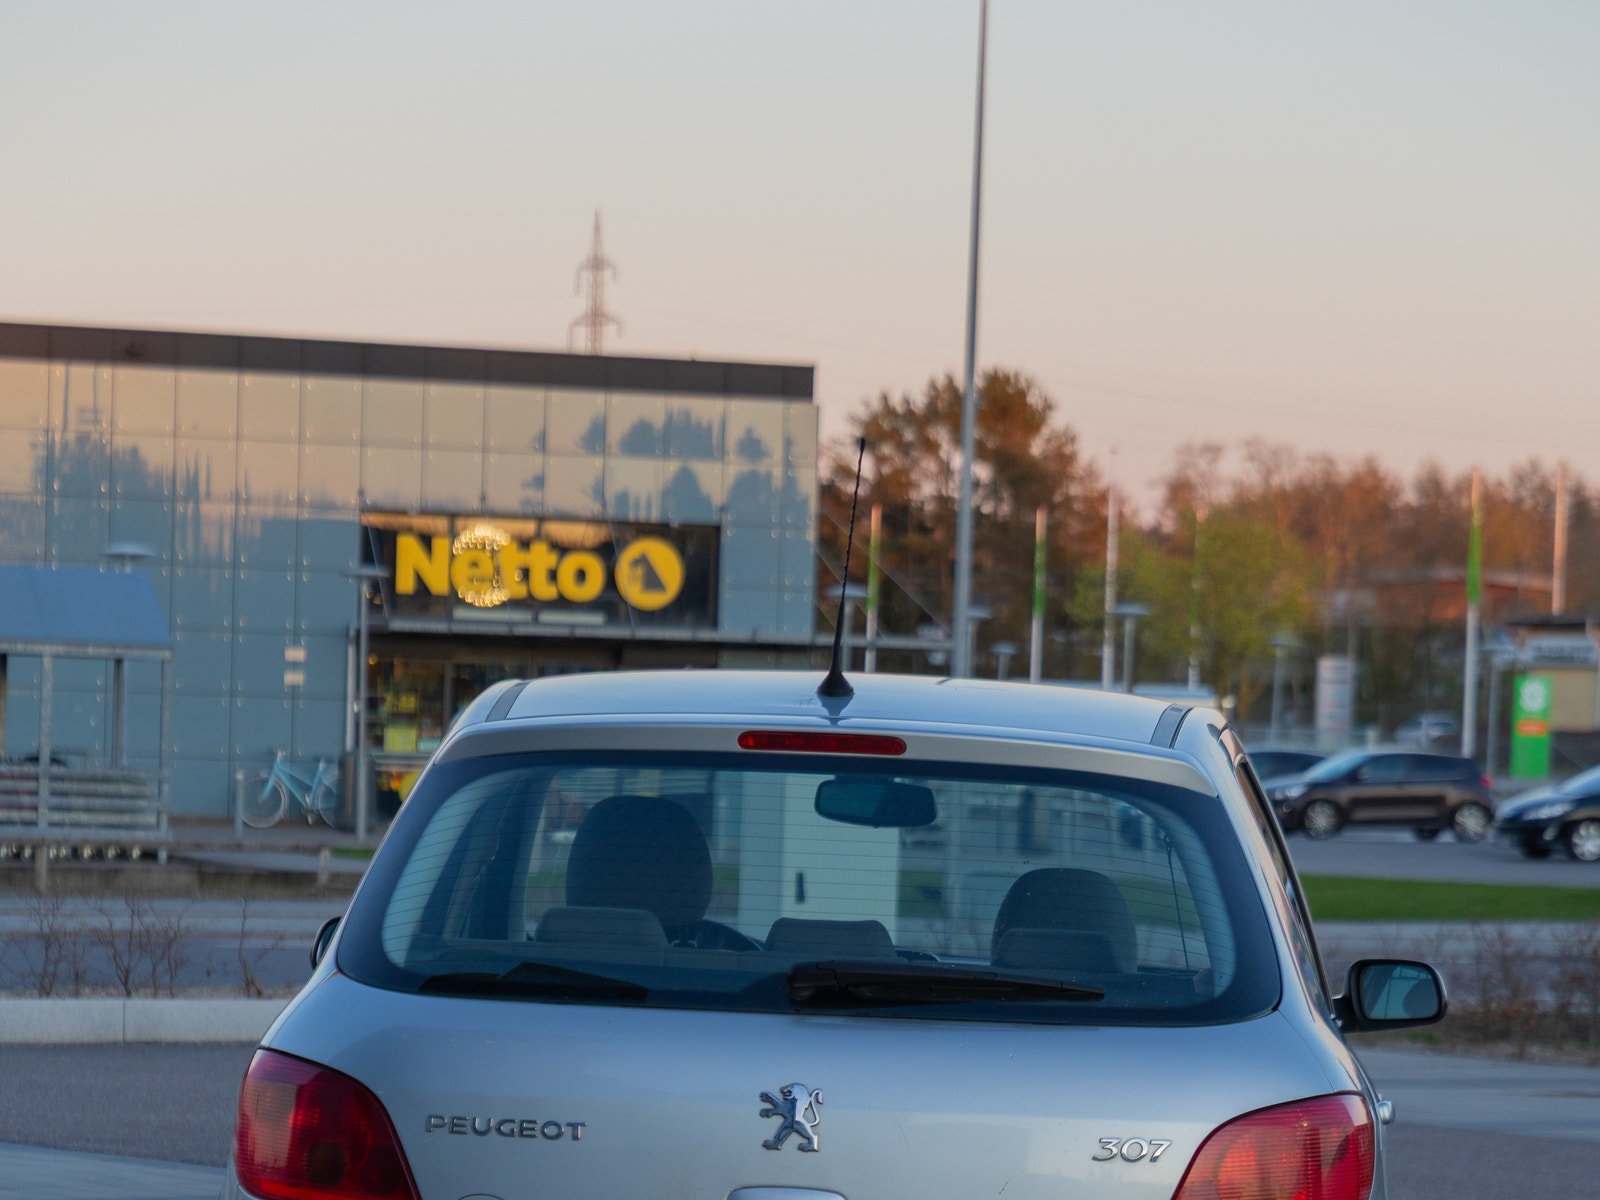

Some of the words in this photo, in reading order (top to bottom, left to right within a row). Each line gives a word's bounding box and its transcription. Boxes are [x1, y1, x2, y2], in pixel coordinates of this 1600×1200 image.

[395, 531, 607, 603] Netto
[425, 1114, 588, 1141] PEUGEOT
[1091, 1137, 1172, 1163] 307
